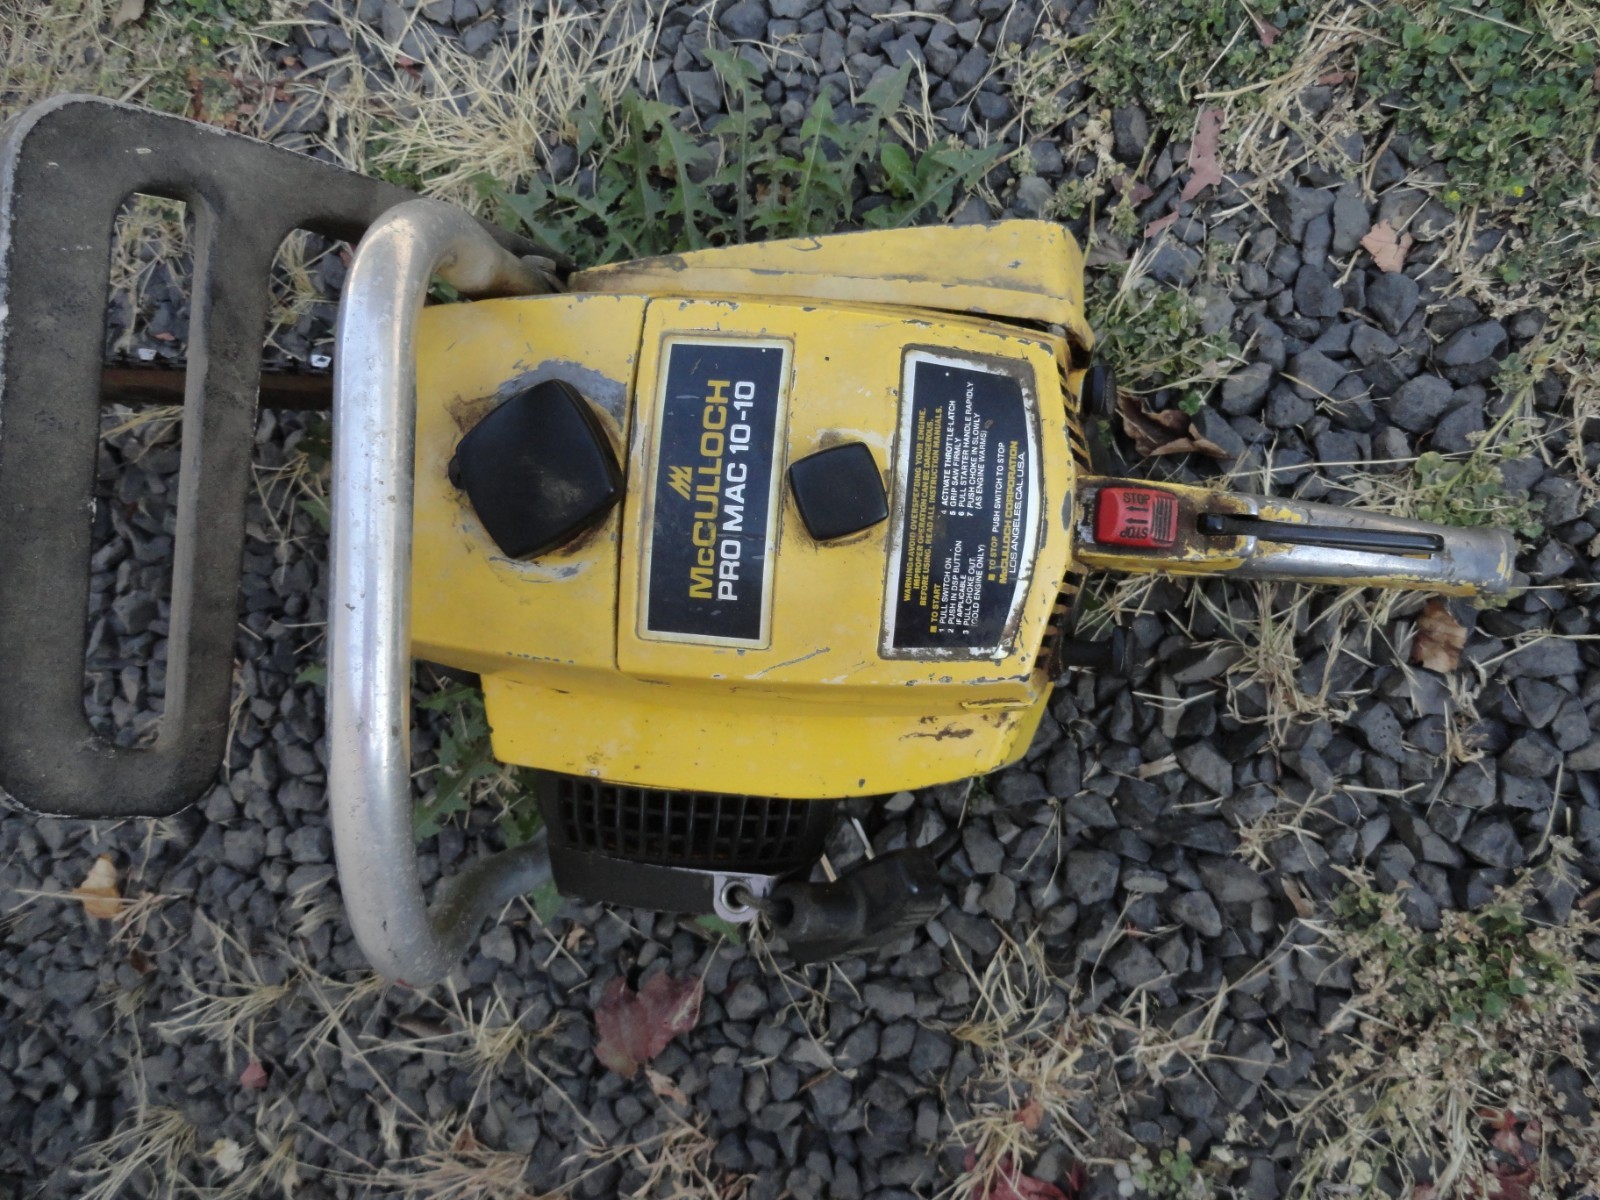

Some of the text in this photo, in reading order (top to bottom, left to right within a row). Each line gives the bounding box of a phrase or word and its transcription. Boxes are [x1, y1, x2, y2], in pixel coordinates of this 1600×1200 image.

[944, 400, 956, 467] THROTTLE-LATCH
[960, 450, 969, 485] STARTER
[965, 382, 974, 414] RAPIDLY
[972, 413, 980, 445] SLOWLY
[923, 470, 929, 480] BE
[976, 464, 984, 494] ENGINE
[996, 466, 1003, 476] TO
[689, 380, 730, 599] McCULLOCH
[718, 381, 755, 600] PRO MAC 10-10
[942, 470, 950, 506] ACTIVATE
[994, 478, 1002, 509] SWITCH
[1123, 492, 1150, 504] STOP
[918, 499, 927, 544] OPERATION
[920, 575, 928, 605] BEFORE
[930, 448, 939, 503] INSTRUCTION
[992, 511, 1000, 532] PUSH
[999, 441, 1018, 584] McCULLOCH CORPORATION
[1120, 526, 1148, 538] STOP
[914, 546, 923, 589] IMPROPER
[945, 558, 952, 569] ON
[954, 540, 962, 573] BUTTON
[977, 545, 986, 568] ONLY)
[989, 559, 996, 570] TO
[1009, 552, 1018, 573] LOS
[903, 562, 913, 601] WARNING
[942, 572, 950, 602] SWITCH
[957, 574, 966, 617] APPLICABLE
[966, 577, 974, 604] CHOKE
[974, 570, 982, 600] ENGINE
[931, 584, 940, 622] TO START
